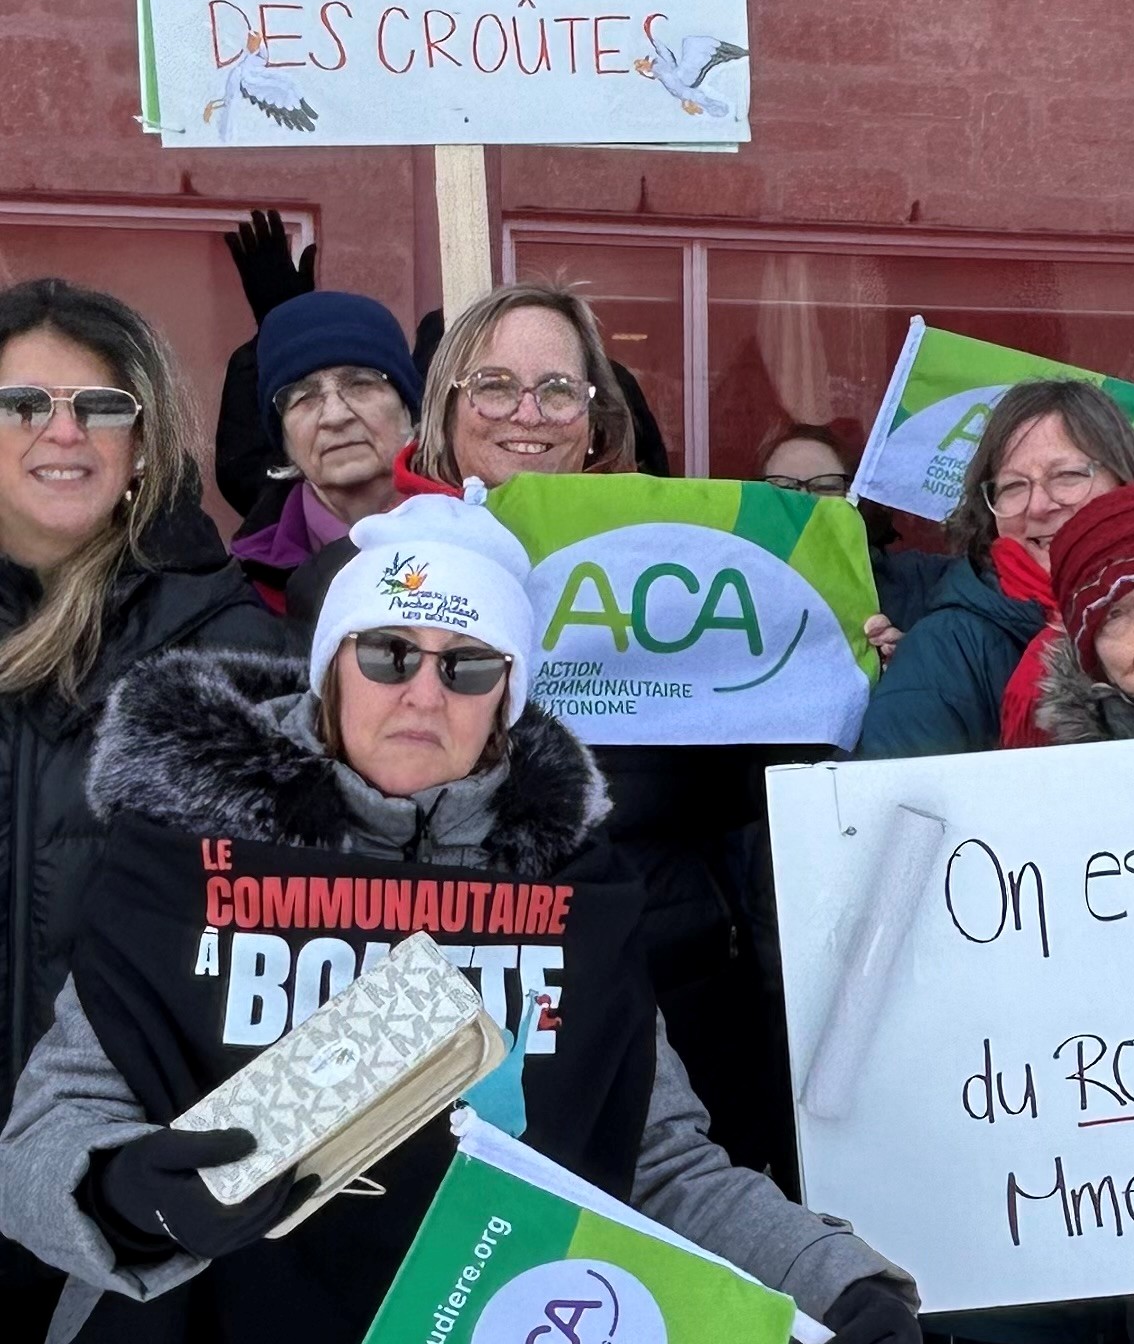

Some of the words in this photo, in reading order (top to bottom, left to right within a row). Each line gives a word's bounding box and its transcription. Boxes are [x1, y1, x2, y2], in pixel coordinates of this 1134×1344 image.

[541, 560, 765, 657] ACA
[532, 679, 693, 698] COMMUNAUTAIRE
[536, 661, 603, 678] ACTION
[202, 838, 233, 871] LE
[206, 876, 575, 935] COMMUNAUTAIRE
[945, 837, 1050, 958] On
[962, 1038, 1041, 1124] du
